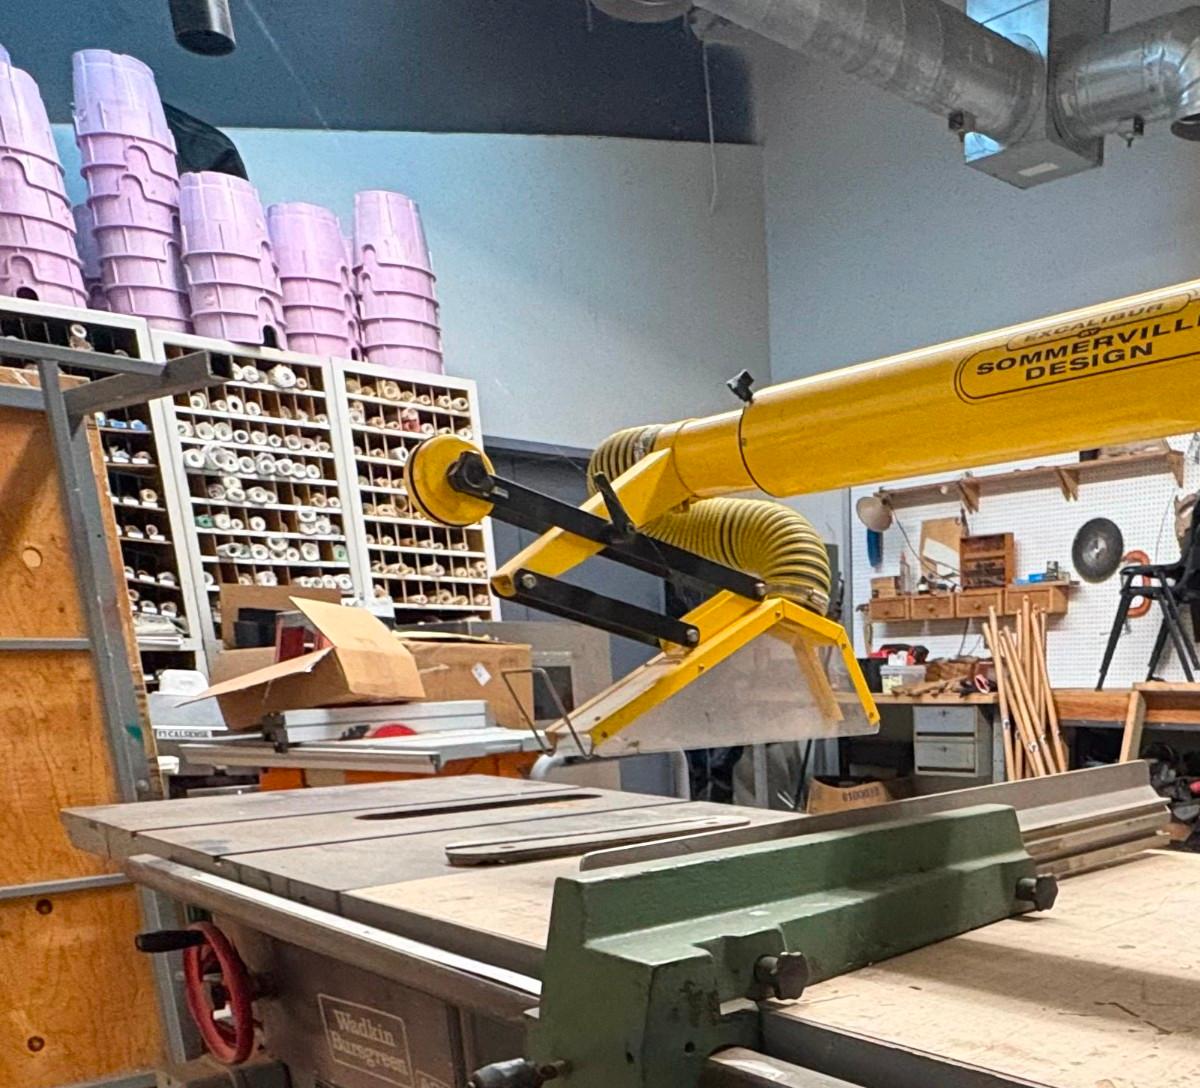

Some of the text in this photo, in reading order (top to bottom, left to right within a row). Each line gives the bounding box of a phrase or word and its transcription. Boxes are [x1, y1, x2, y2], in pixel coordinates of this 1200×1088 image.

[1023, 302, 1166, 342] EXCALIBUR
[1024, 342, 1154, 382] DESIGN
[332, 1009, 398, 1048] Wadkin
[329, 1030, 409, 1077] Bursgreen
